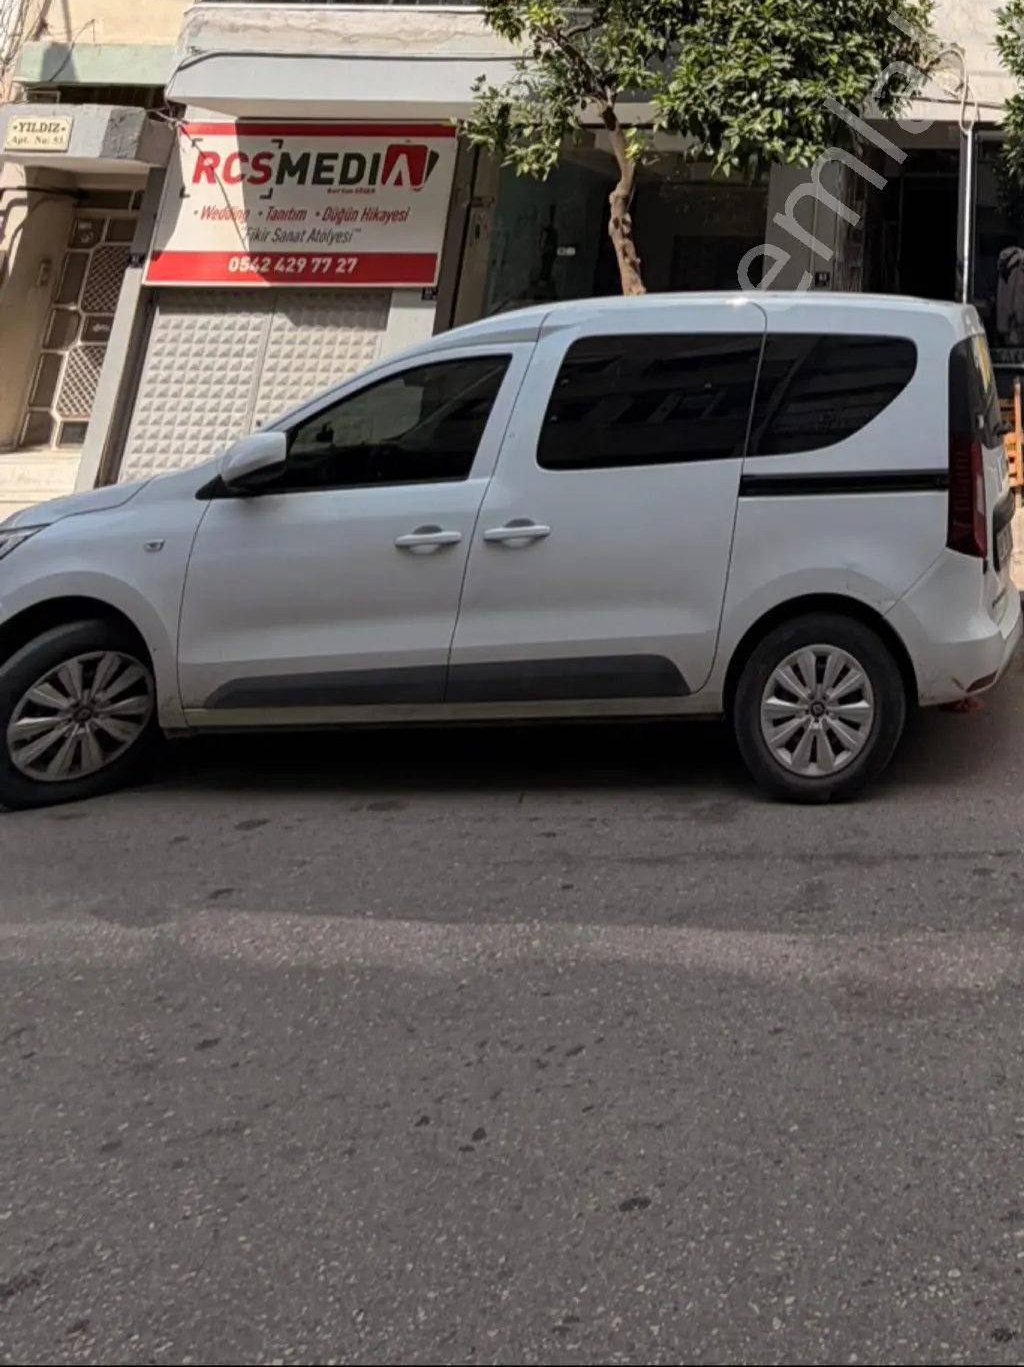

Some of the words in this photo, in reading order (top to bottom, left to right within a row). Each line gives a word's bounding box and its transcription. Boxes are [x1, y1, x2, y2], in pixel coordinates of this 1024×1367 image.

[200, 206, 250, 223] Wedding
[322, 206, 358, 224] Düğün
[360, 206, 411, 225] Hikayesi
[271, 228, 306, 243] Sanat
[228, 256, 271, 272] 0542
[274, 257, 308, 272] 429
[311, 257, 333, 272] 77
[335, 257, 359, 272] 27
